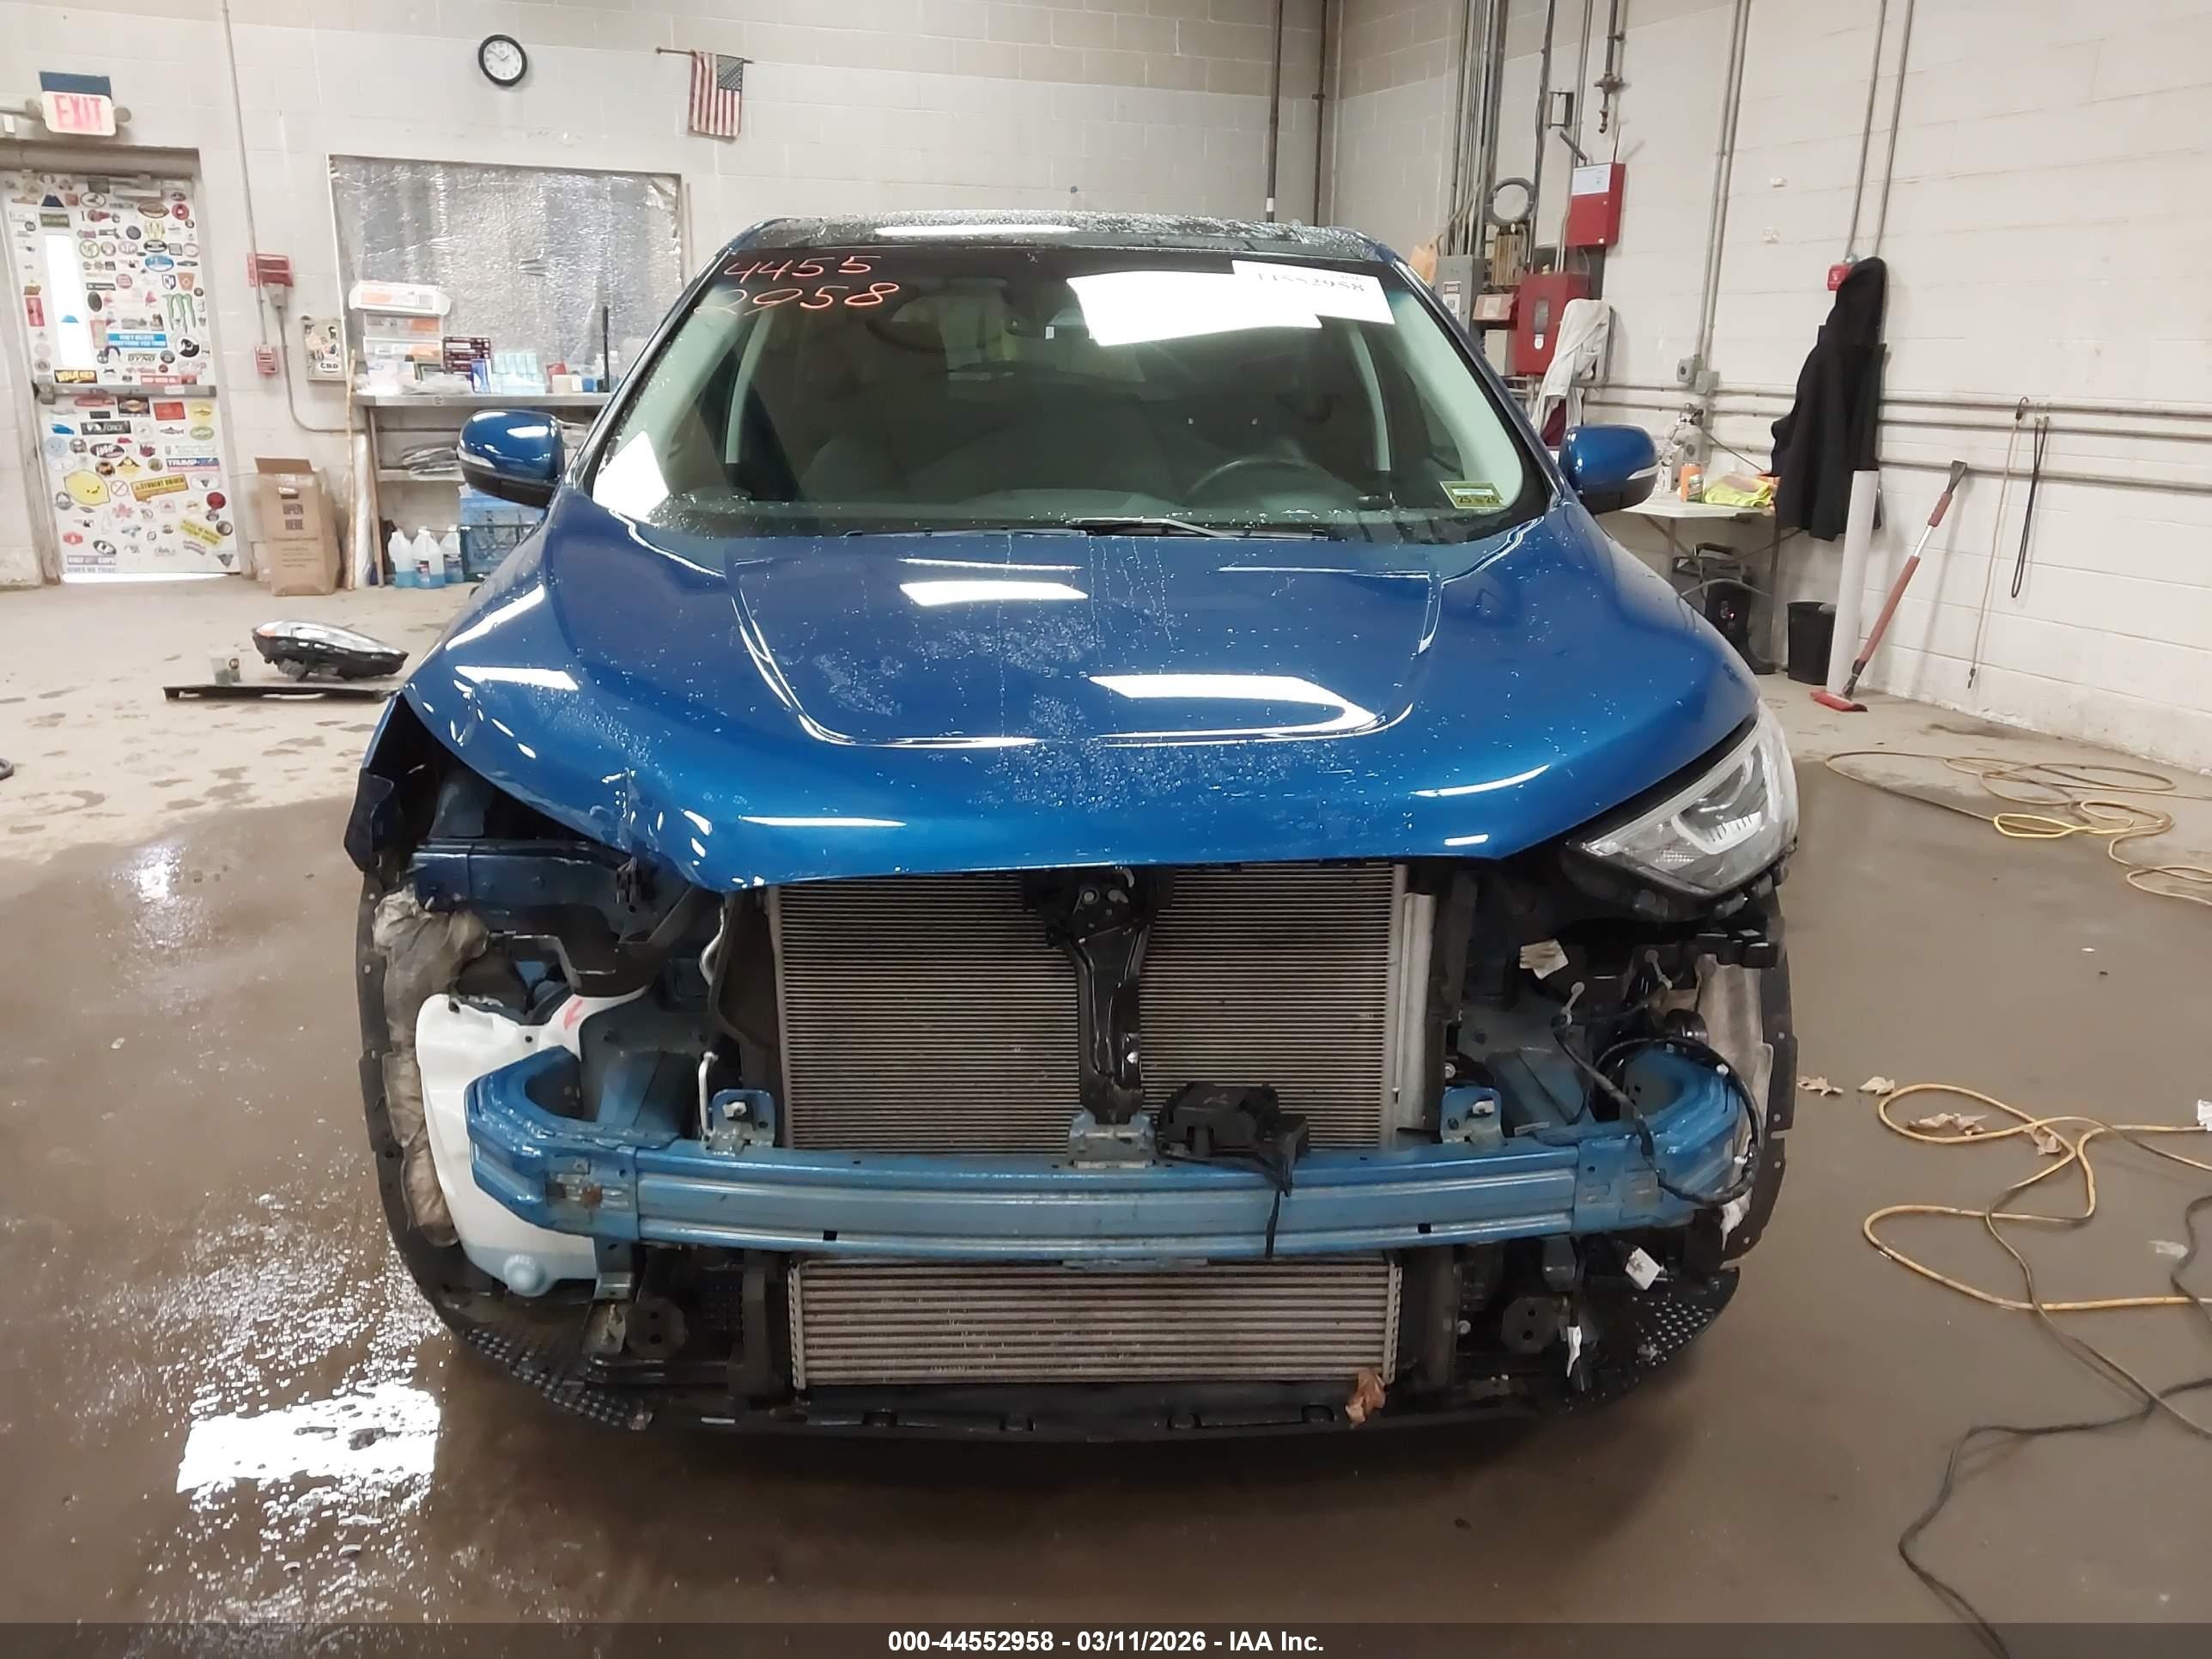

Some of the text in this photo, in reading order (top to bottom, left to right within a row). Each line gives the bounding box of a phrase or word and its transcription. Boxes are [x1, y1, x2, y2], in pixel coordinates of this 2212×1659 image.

[54, 94, 102, 131] EXIT
[723, 256, 882, 283] 4455
[693, 283, 901, 316] 2958
